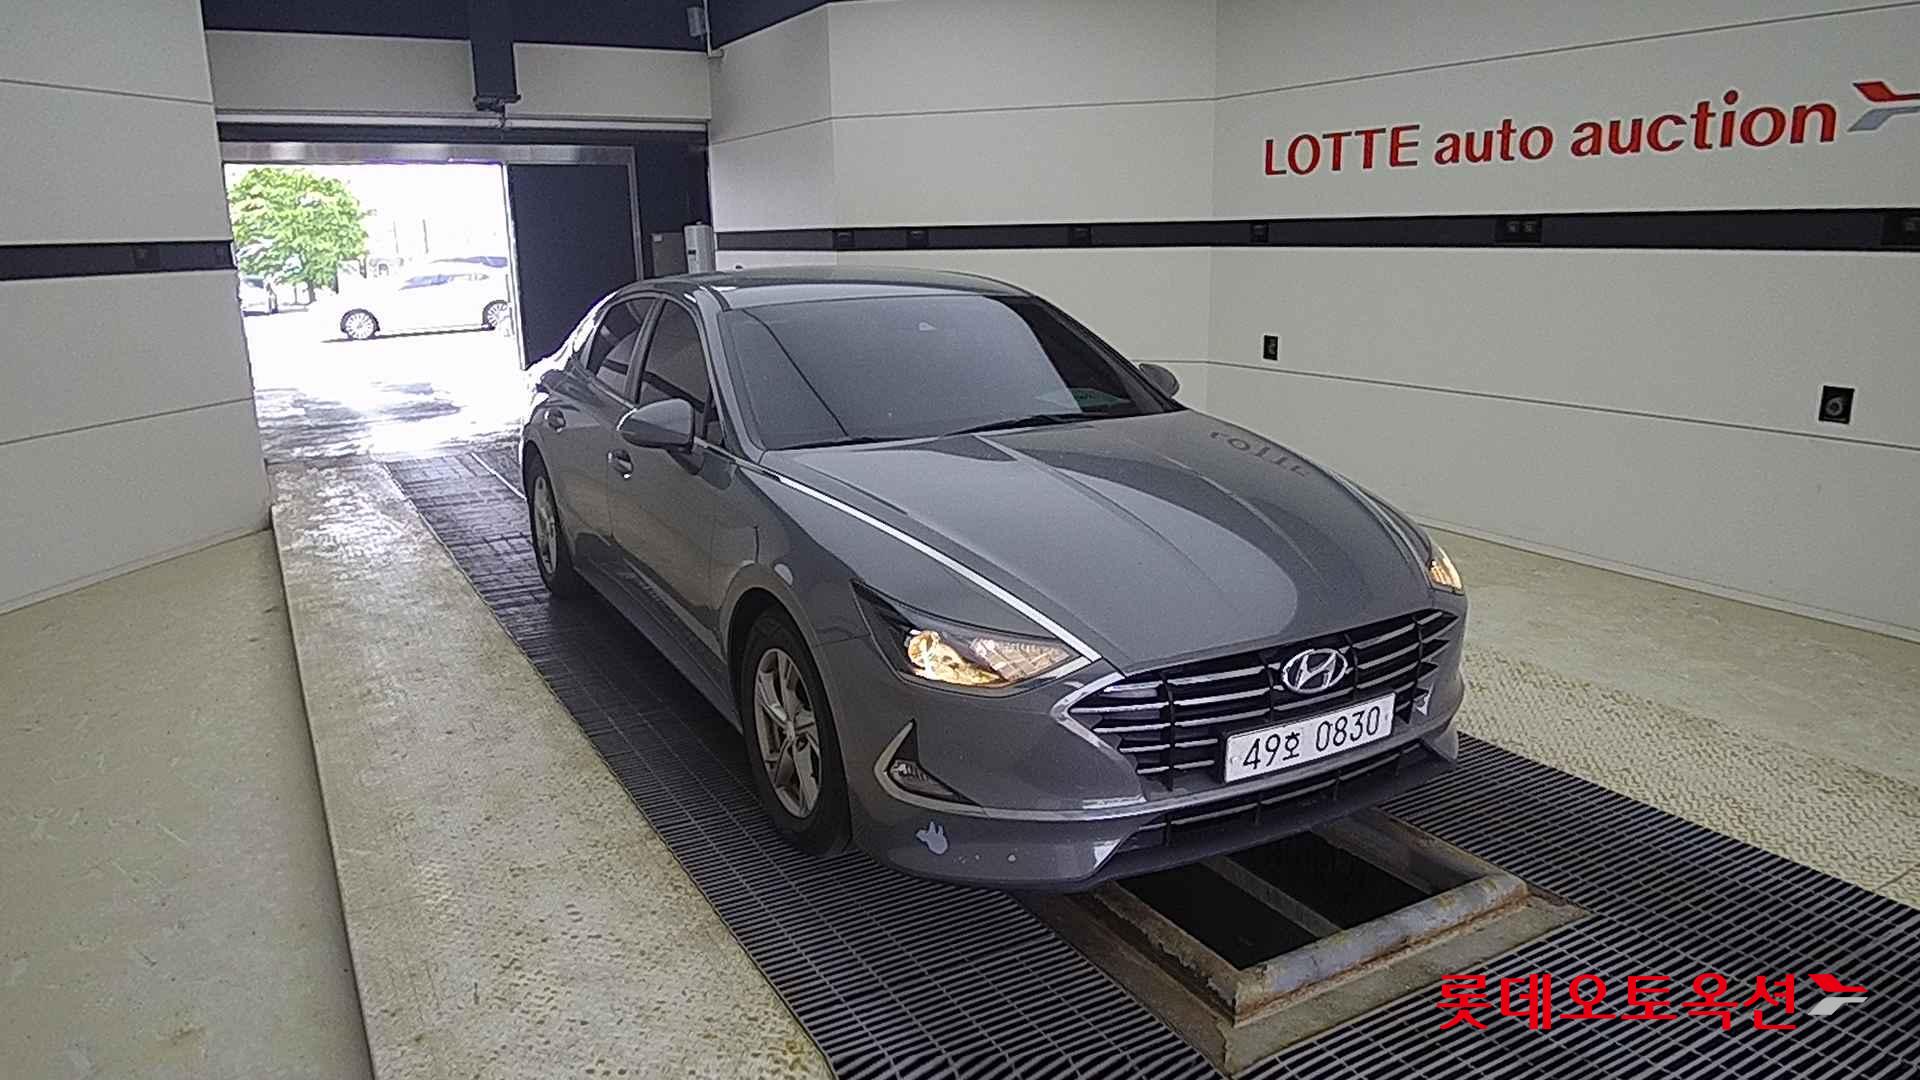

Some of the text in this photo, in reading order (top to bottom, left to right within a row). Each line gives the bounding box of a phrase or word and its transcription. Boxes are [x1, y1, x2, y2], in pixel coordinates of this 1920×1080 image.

[1264, 90, 1838, 176] LOTTE auto auction
[1242, 706, 1381, 770] 49호 0830
